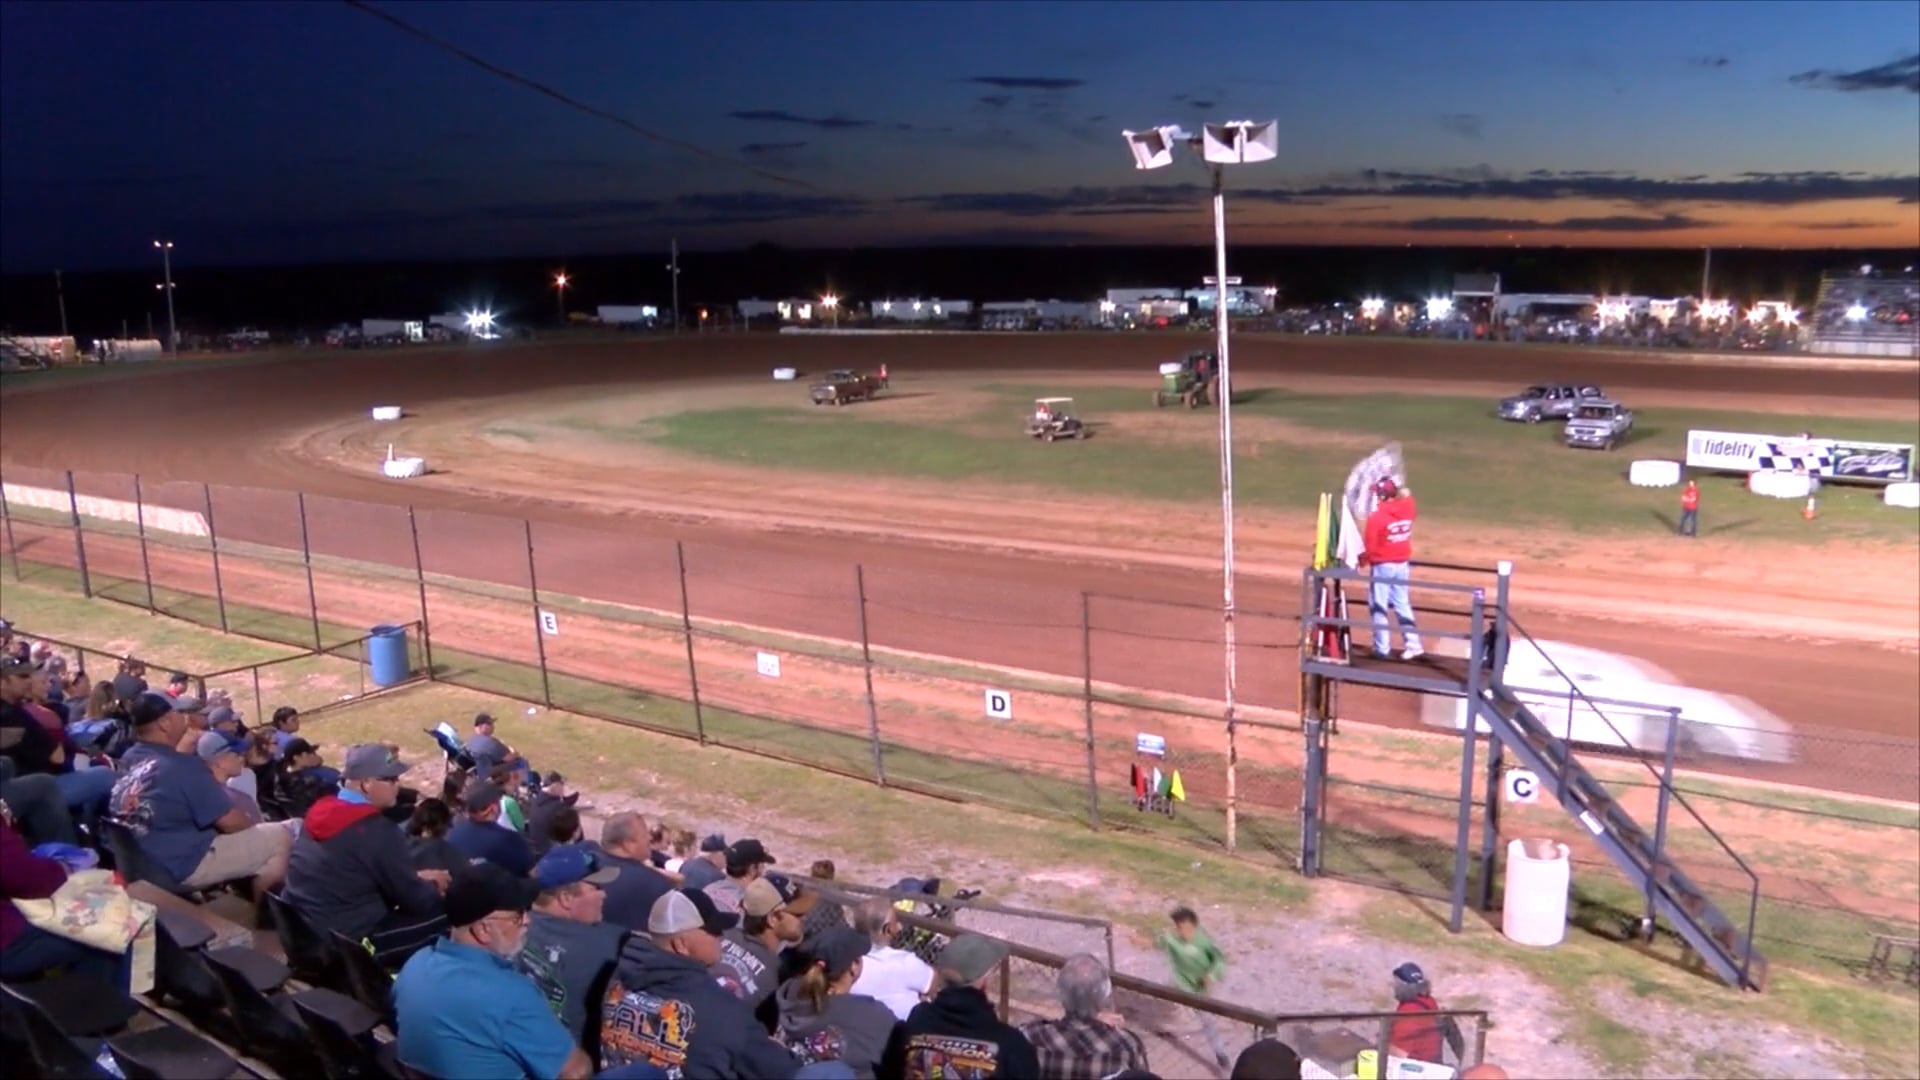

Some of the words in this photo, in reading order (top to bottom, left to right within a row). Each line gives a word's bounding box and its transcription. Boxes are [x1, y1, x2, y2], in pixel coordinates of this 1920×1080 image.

[1704, 439, 1756, 459] fidelity
[545, 616, 555, 631] E
[992, 695, 1006, 713] D
[1513, 777, 1532, 797] C
